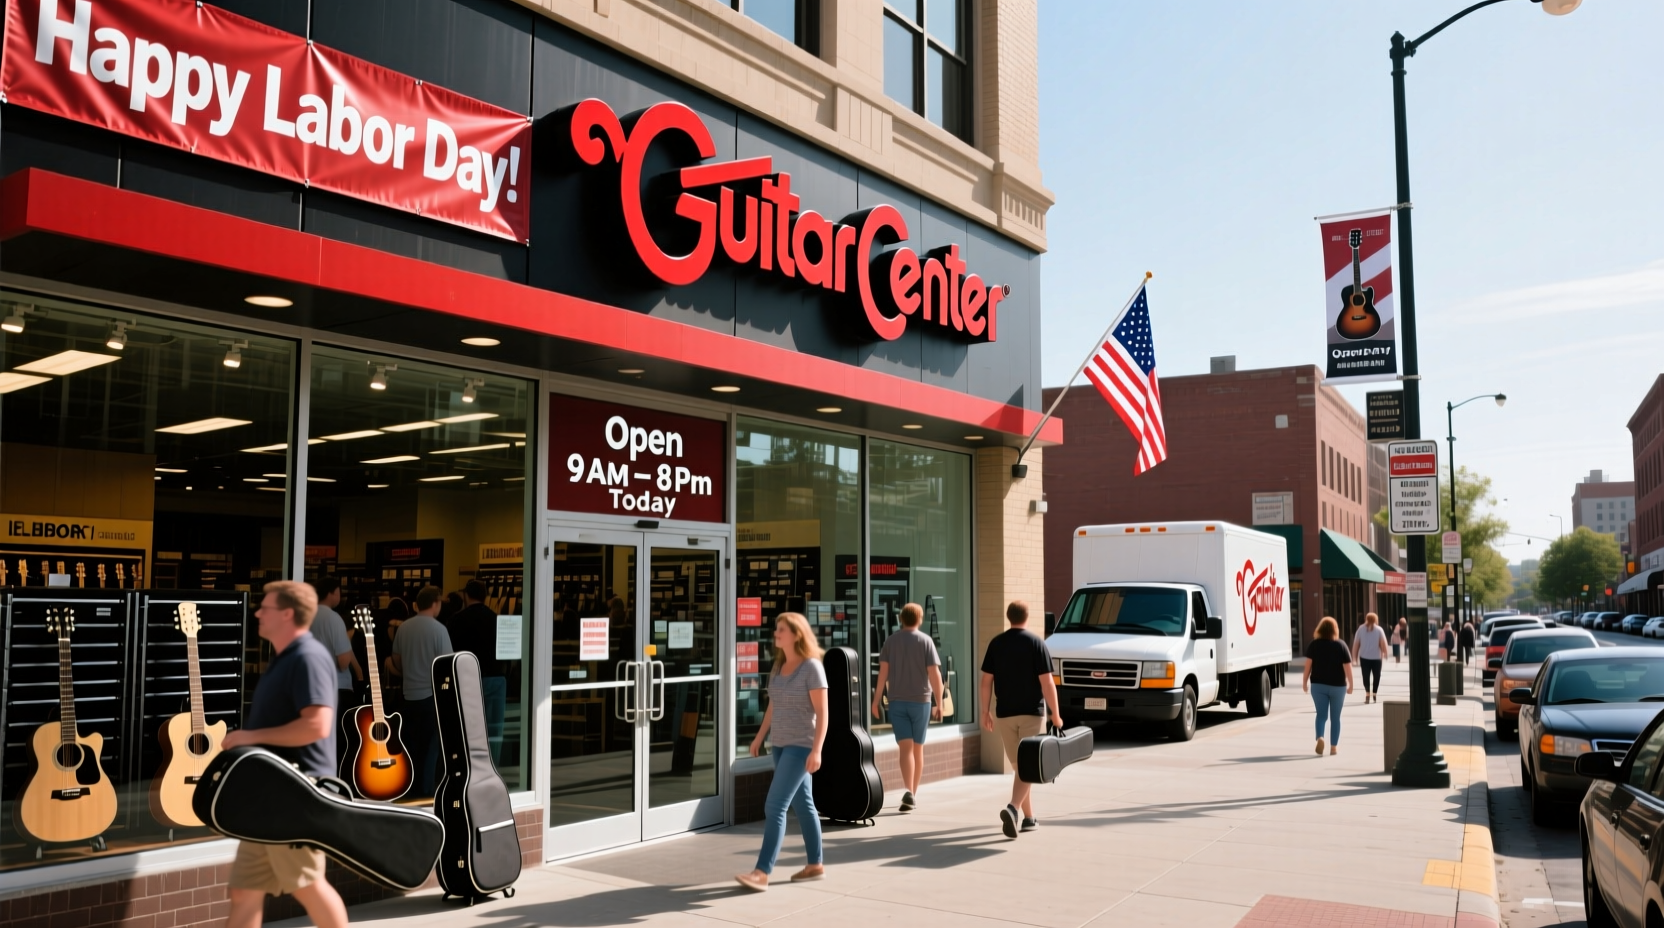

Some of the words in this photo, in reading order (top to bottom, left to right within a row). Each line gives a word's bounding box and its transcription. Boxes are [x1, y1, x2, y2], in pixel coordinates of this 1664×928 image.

[35, 0, 251, 136] Happy
[263, 64, 415, 170] Labor
[423, 118, 521, 213] Day!
[571, 98, 856, 292] Guitar
[857, 204, 1003, 342] Center
[605, 415, 683, 461] Open
[609, 488, 676, 518] Today
